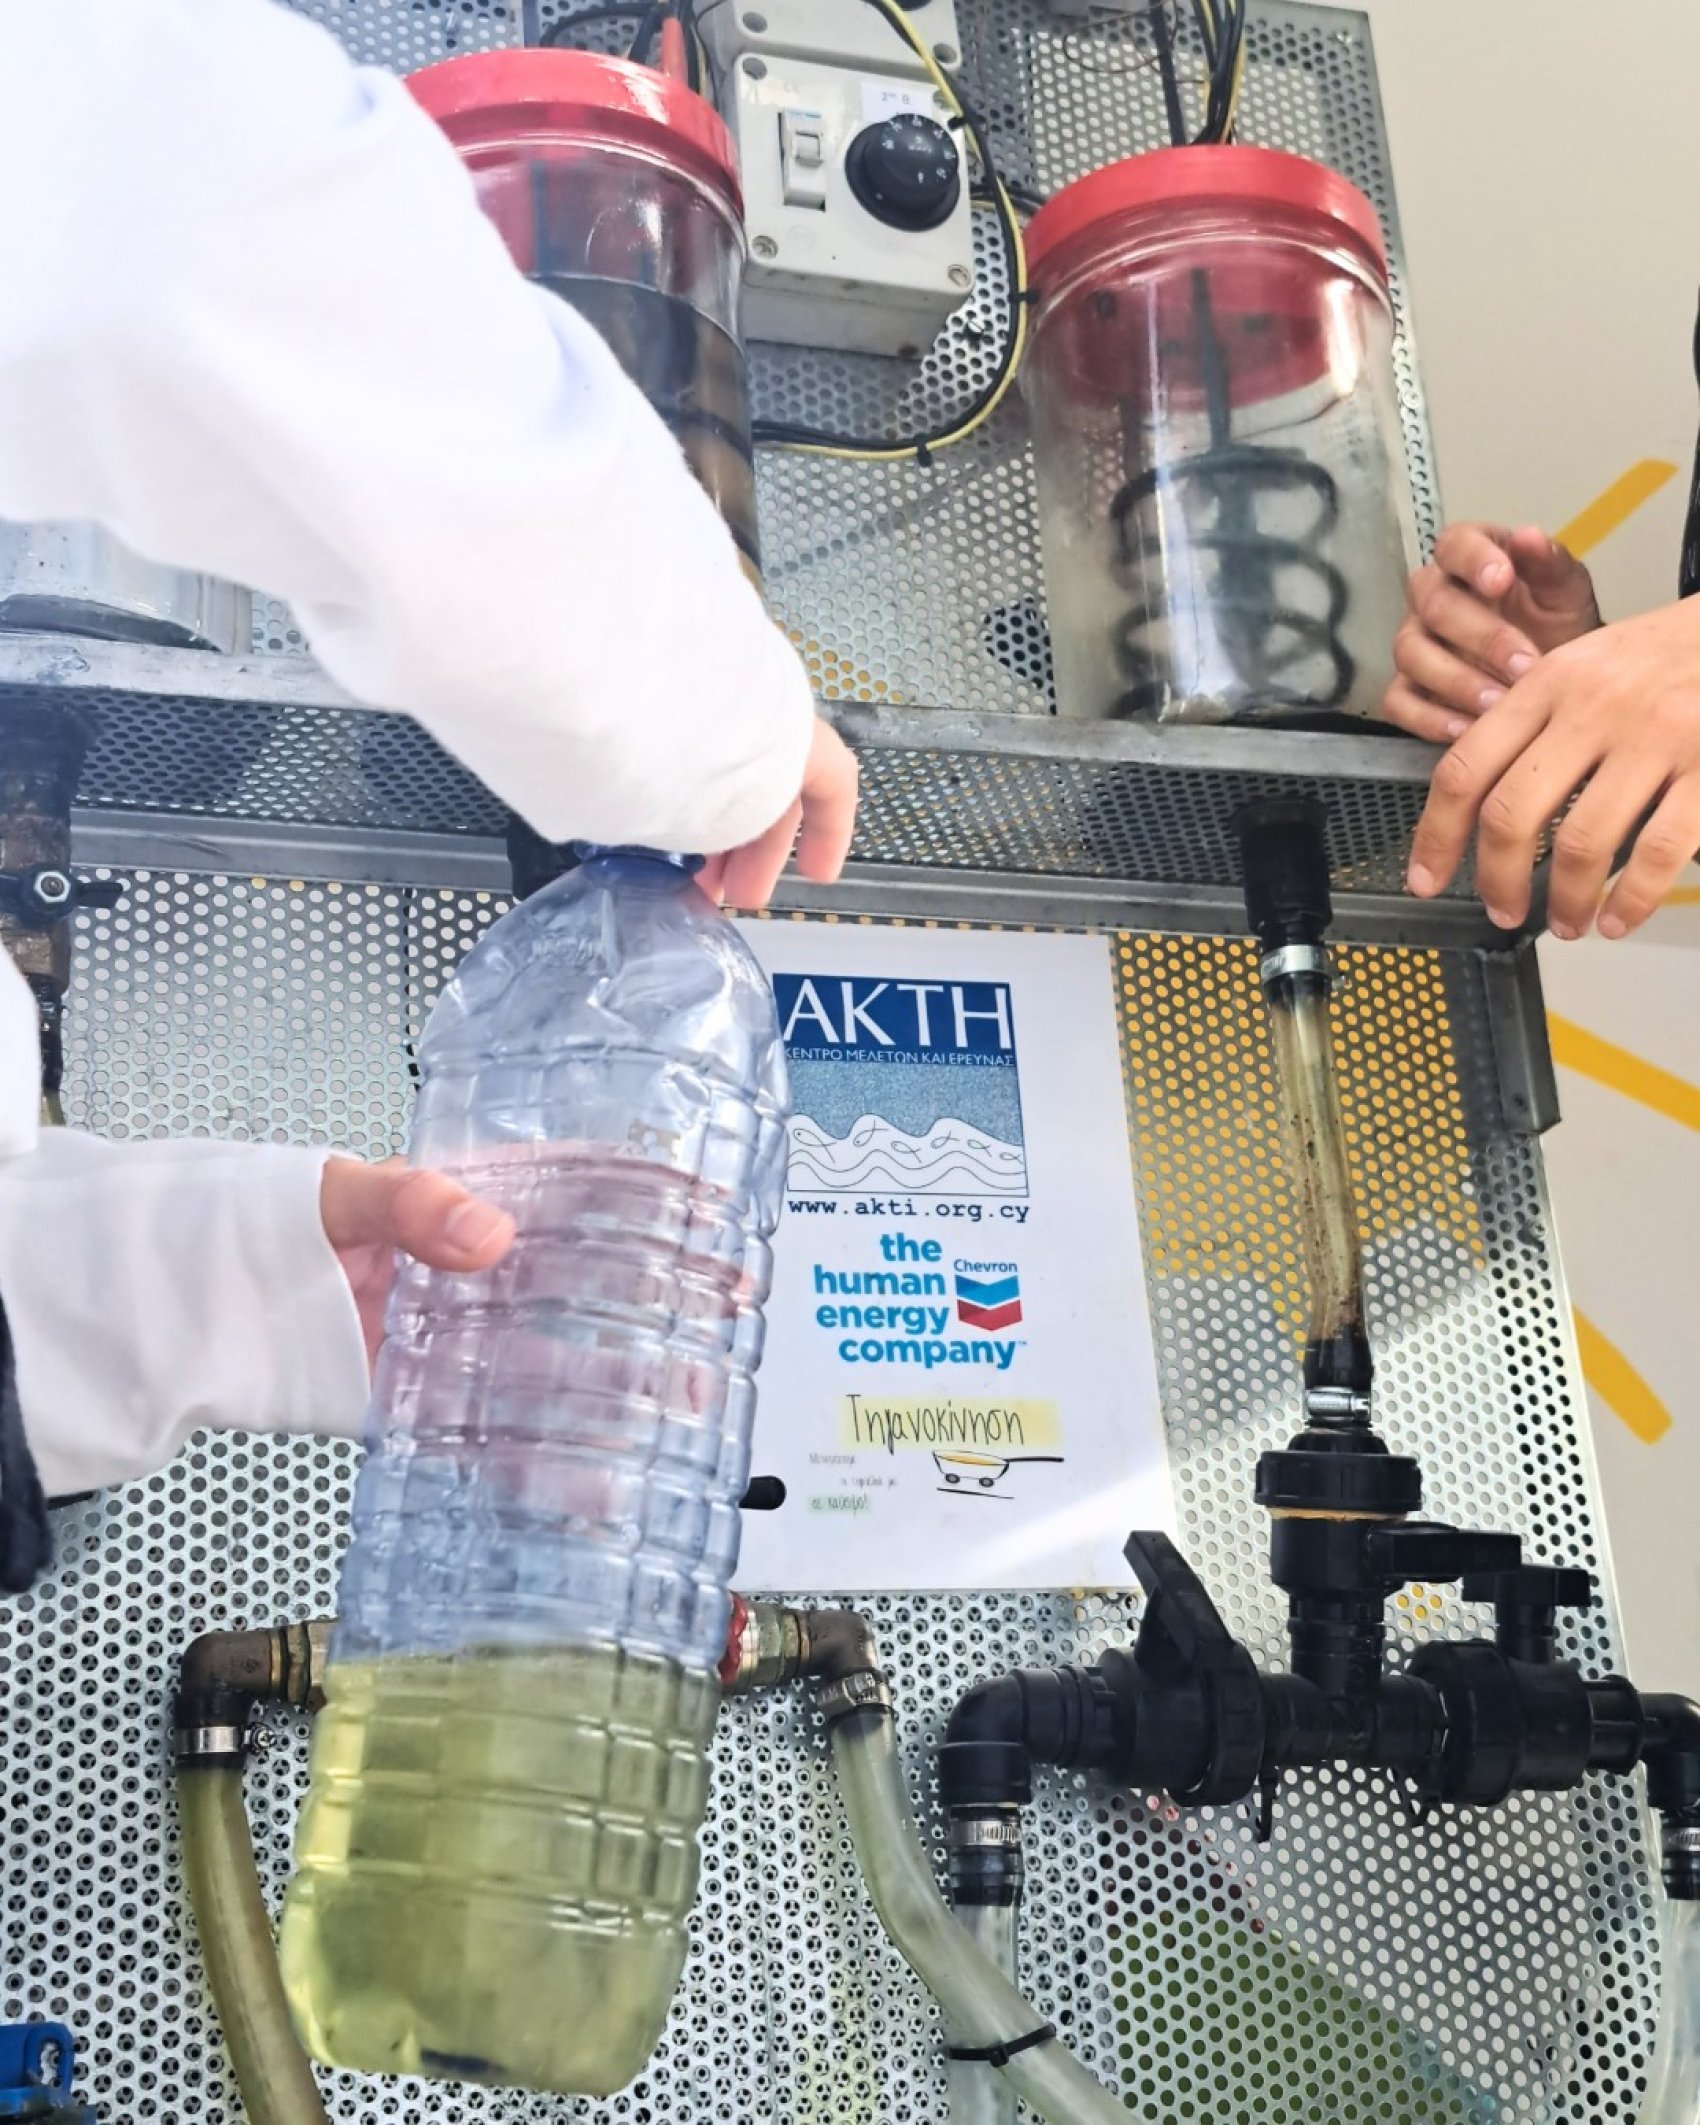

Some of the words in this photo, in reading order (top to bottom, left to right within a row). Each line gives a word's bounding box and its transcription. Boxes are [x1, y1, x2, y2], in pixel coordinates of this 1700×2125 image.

[783, 978, 1012, 1049] ΑΚΤΗ
[784, 1047, 842, 1060] ΚΕΝΤΡΟ
[846, 1049, 917, 1063] ΜΕΛΕΤΩΝ
[921, 1052, 945, 1064] ΚΑΙ
[948, 1052, 1014, 1066] ΕΡΕΥΝΑΣ
[788, 1198, 1030, 1222] www.akti.org.cy
[879, 1232, 943, 1262] the
[813, 1264, 946, 1295] human
[953, 1258, 1018, 1273] Chevron
[815, 1304, 950, 1335] energy
